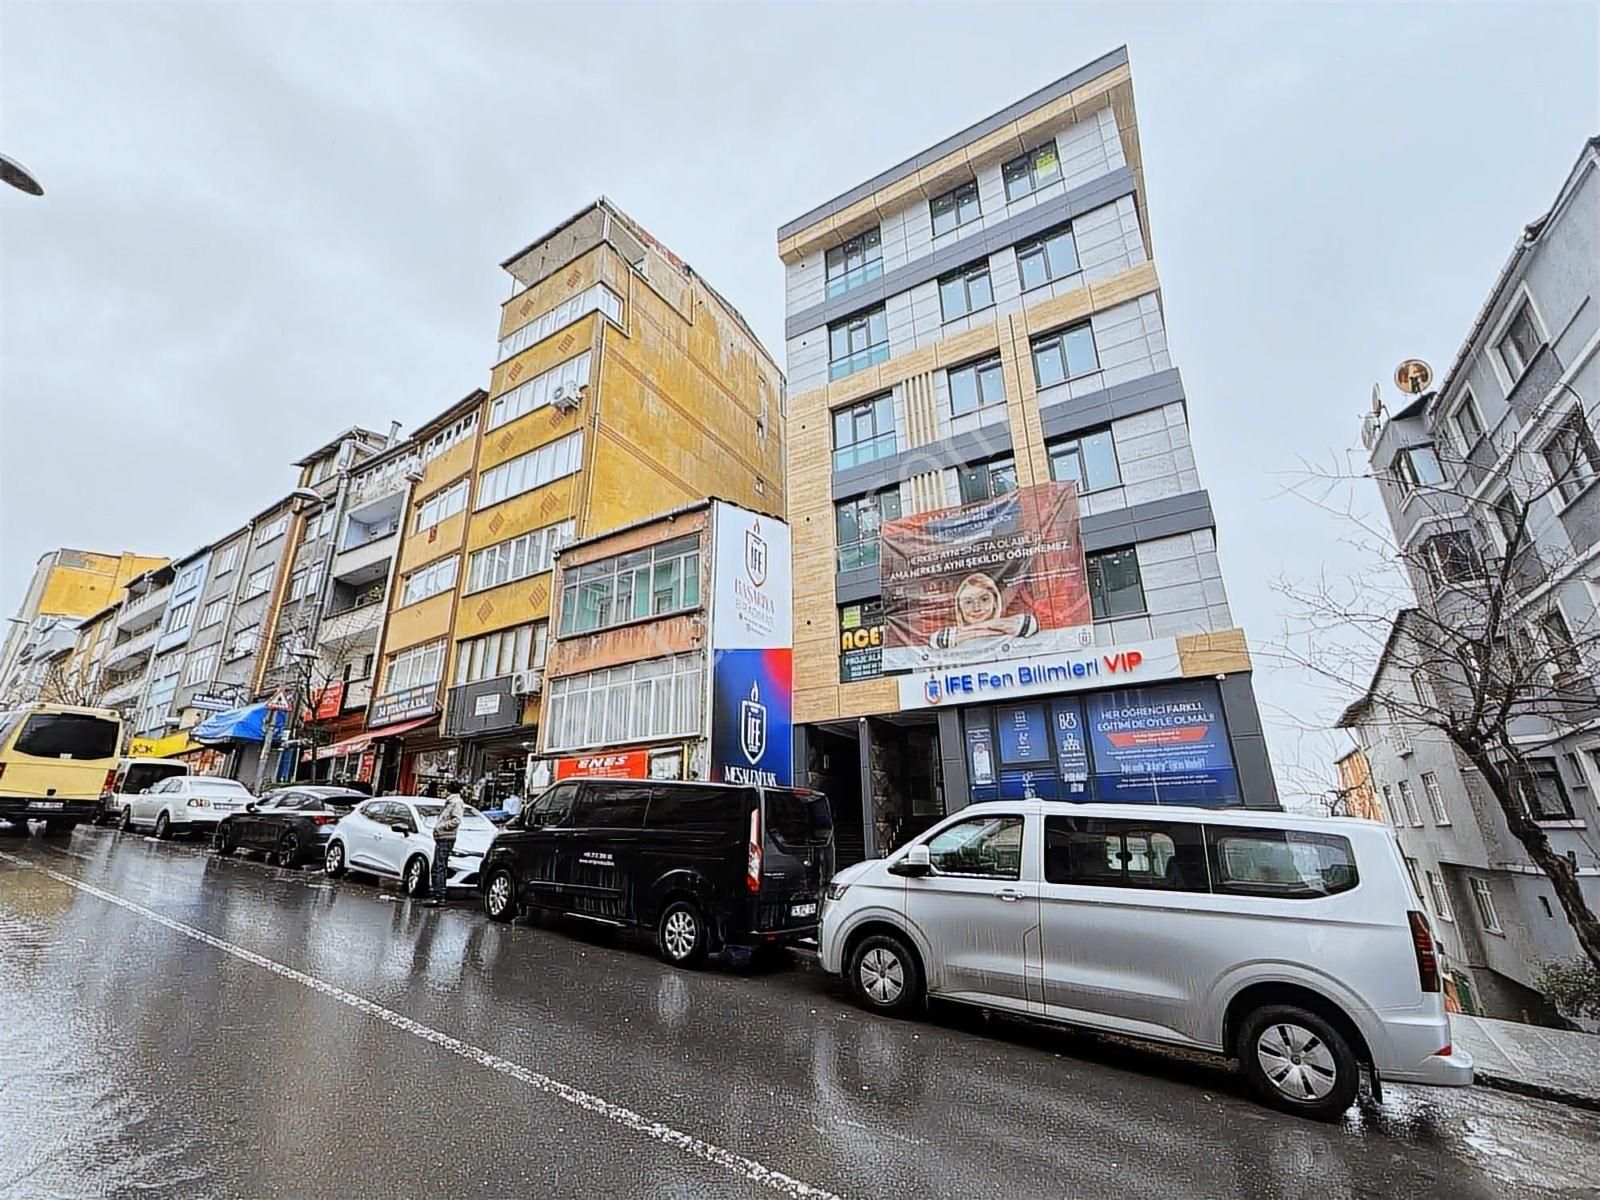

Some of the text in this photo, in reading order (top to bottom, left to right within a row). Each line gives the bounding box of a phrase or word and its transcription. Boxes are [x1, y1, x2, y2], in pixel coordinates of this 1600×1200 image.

[890, 569, 909, 582] AMA
[911, 563, 943, 578] HERKES
[943, 559, 965, 572] AYNI
[966, 552, 1006, 570] ŞEKİLDE
[945, 673, 973, 696] İFE
[978, 671, 1014, 690] Fen
[1018, 658, 1099, 686] Bilimleri
[1104, 651, 1143, 674] VIP
[1102, 709, 1120, 720] HER
[1121, 704, 1166, 718] ÖĞRENCİ
[1131, 719, 1146, 729] DE
[1146, 715, 1173, 727] ÖYLE
[578, 755, 628, 769] ENES
